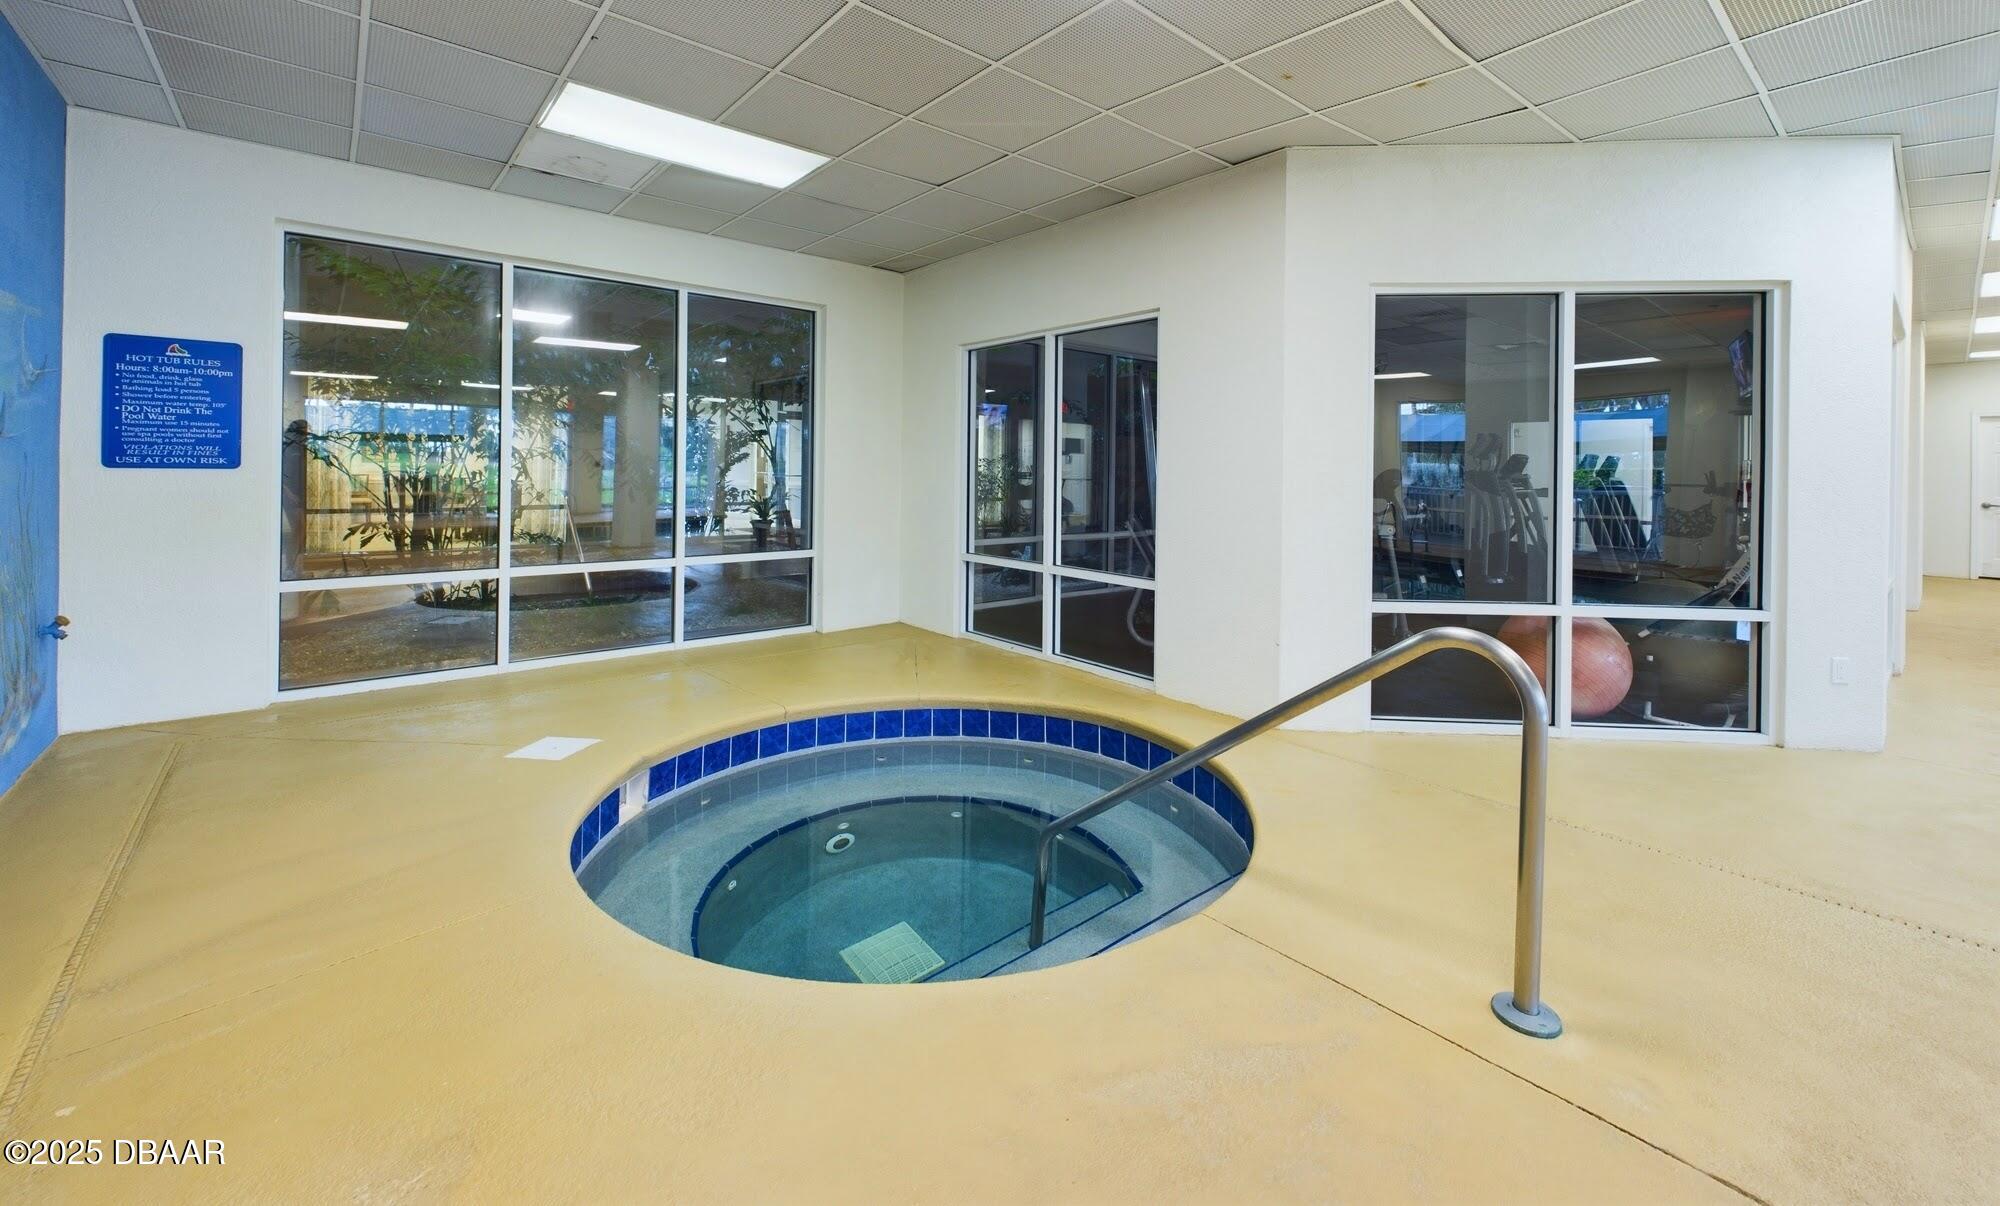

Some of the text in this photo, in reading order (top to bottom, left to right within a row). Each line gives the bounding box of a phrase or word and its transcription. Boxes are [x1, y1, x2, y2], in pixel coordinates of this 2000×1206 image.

[184, 358, 221, 366] RULES
[116, 363, 233, 377] Hours: 8:00am-10:00pm
